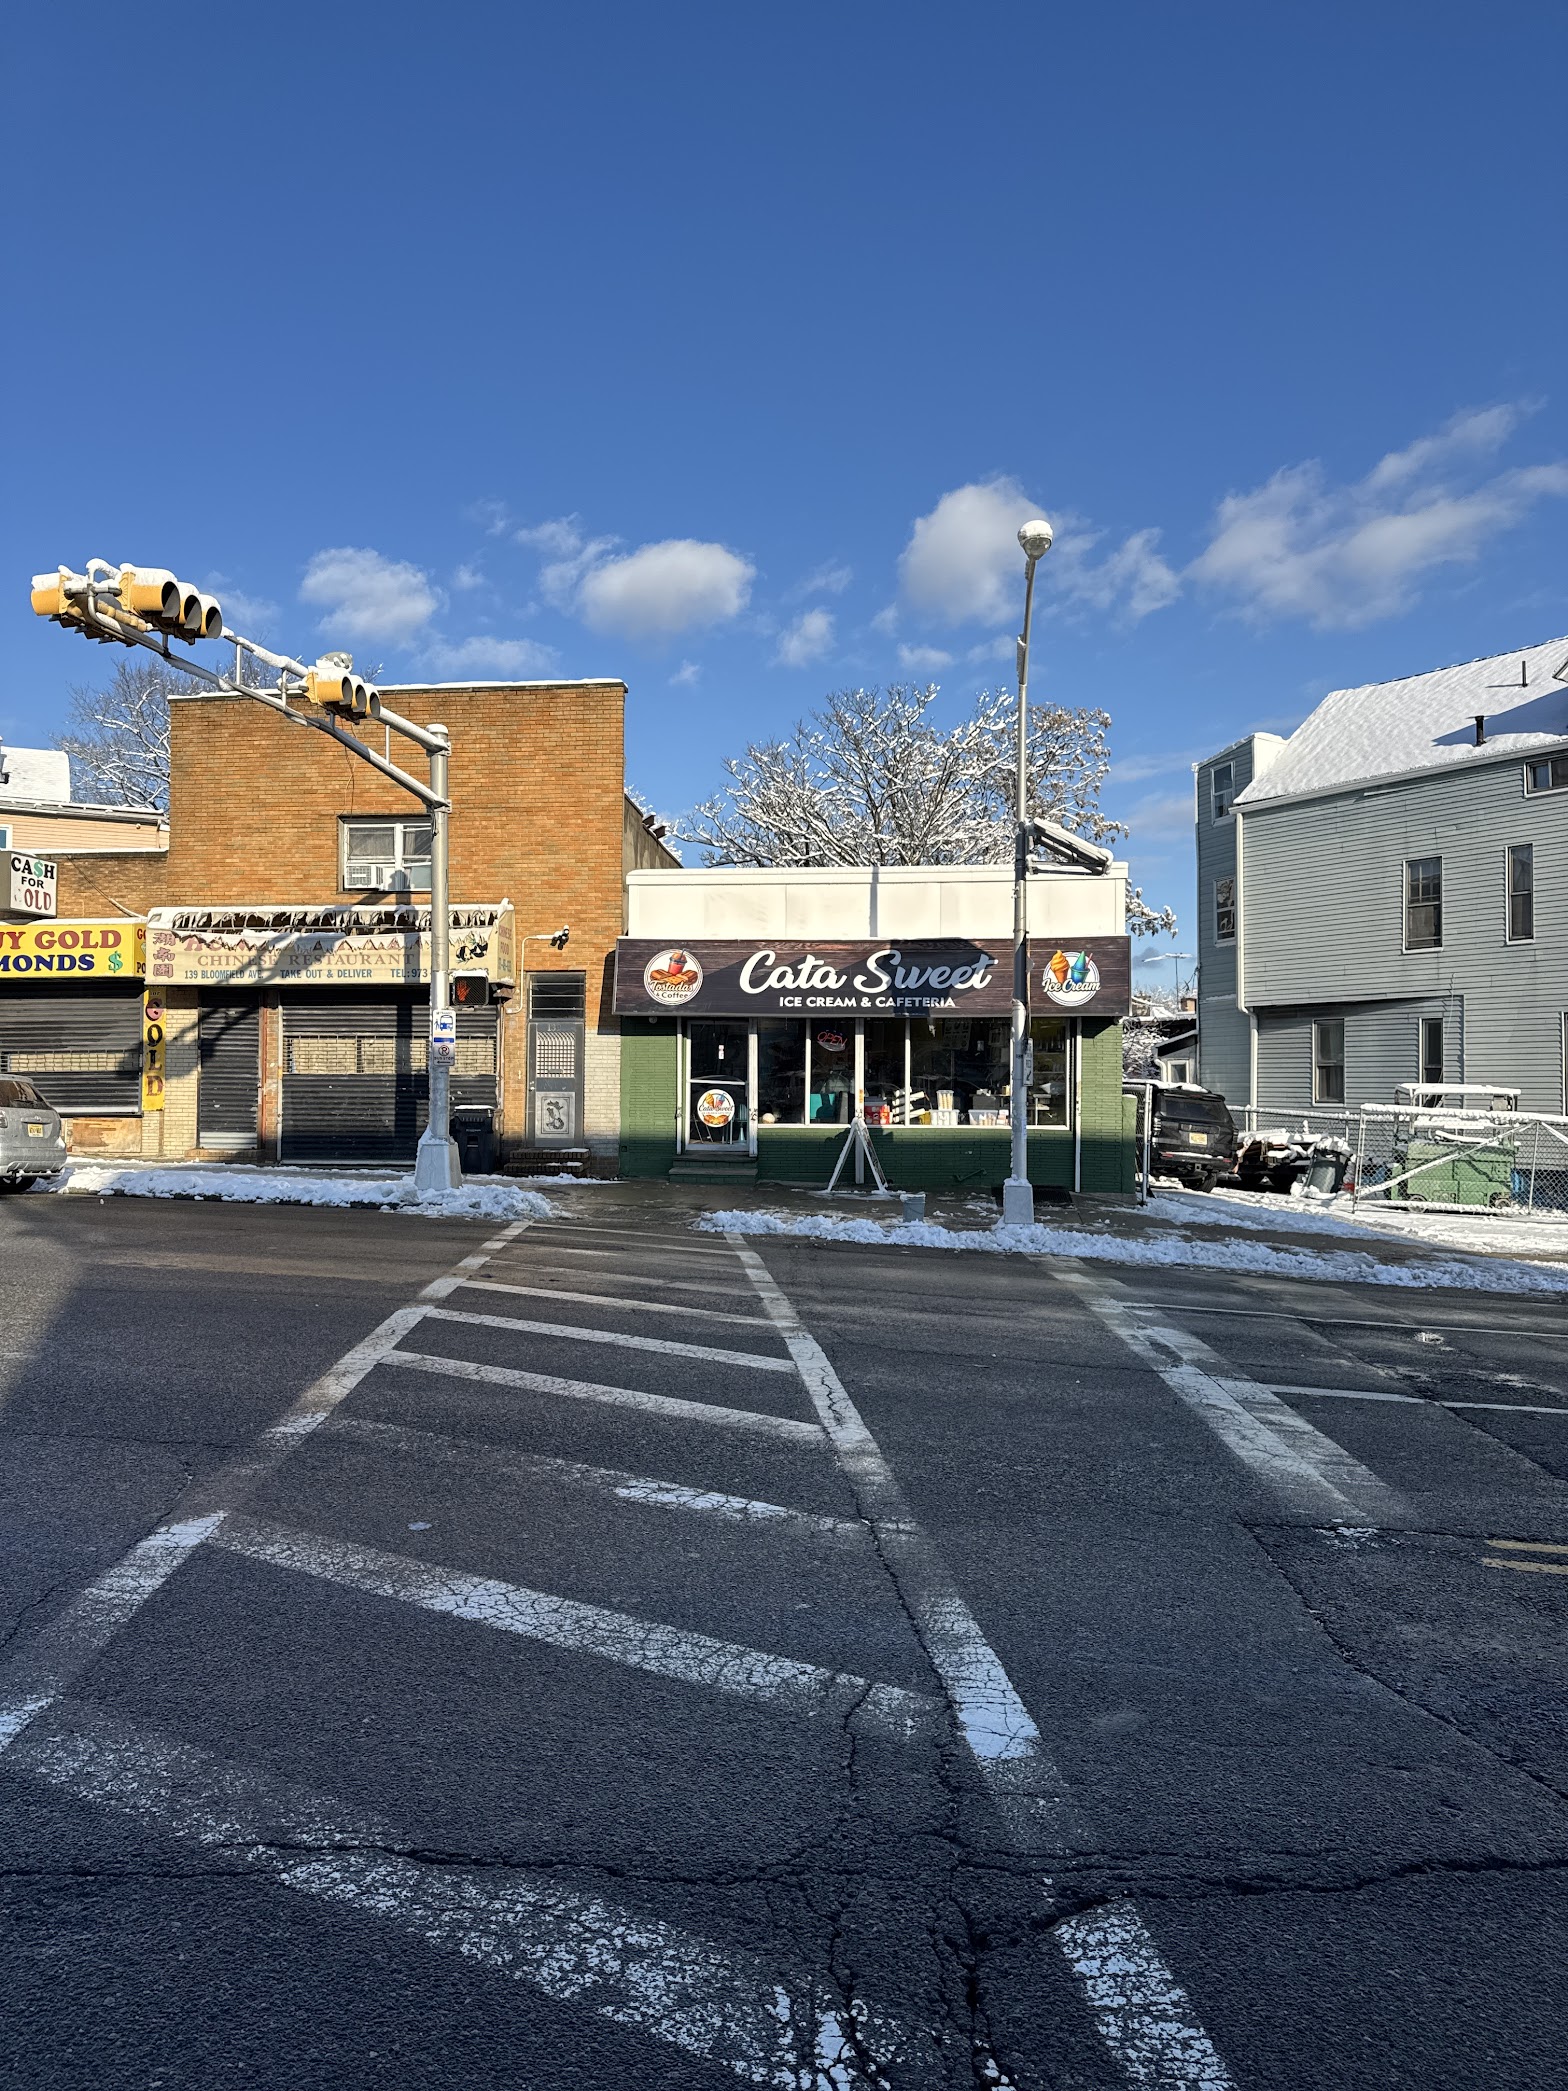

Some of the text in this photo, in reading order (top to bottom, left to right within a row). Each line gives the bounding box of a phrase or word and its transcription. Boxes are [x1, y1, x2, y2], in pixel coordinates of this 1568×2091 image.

[11, 857, 55, 880] CA$H
[21, 876, 44, 889] FOR
[14, 888, 52, 910] OLD
[34, 930, 122, 950] GOLD
[197, 954, 415, 966] CHINESE RESTAURANT
[184, 970, 198, 980] 139
[201, 969, 245, 979] BLOOMFIELD
[248, 969, 264, 979] AVE.
[280, 969, 301, 979] TAKE
[306, 969, 323, 979] OUT
[326, 969, 334, 978] &
[337, 969, 373, 978] DELIVER
[739, 949, 999, 994] Cata Sweet
[648, 980, 693, 992] Tostadas
[1042, 978, 1101, 993] Ice Cream
[779, 996, 956, 1007] ICE CREAM & CAFETERIA
[817, 1031, 848, 1047] OPEN
